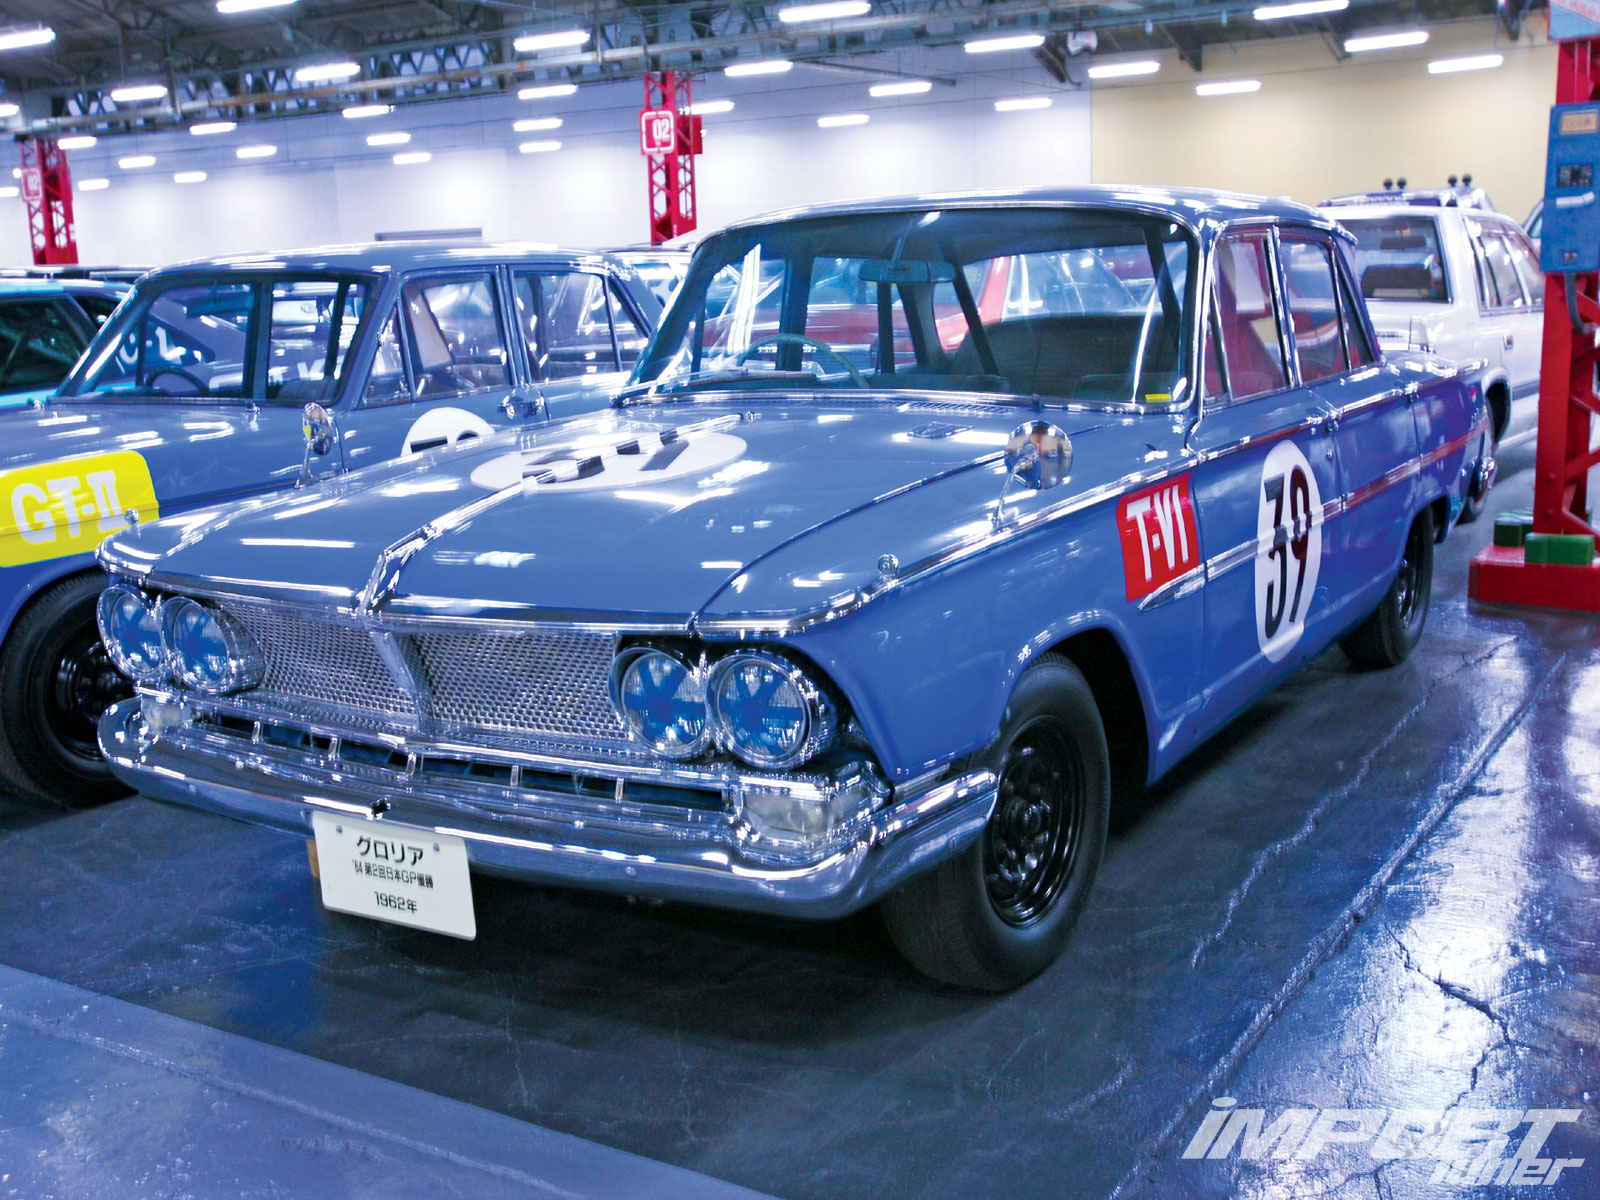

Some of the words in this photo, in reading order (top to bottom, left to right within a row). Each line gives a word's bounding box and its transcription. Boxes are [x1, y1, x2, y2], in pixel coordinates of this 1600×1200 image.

[653, 118, 671, 140] 02
[1126, 484, 1189, 582] T-VI
[1264, 465, 1312, 639] 39
[356, 835, 424, 866] グロリア
[374, 891, 418, 914] 1962年
